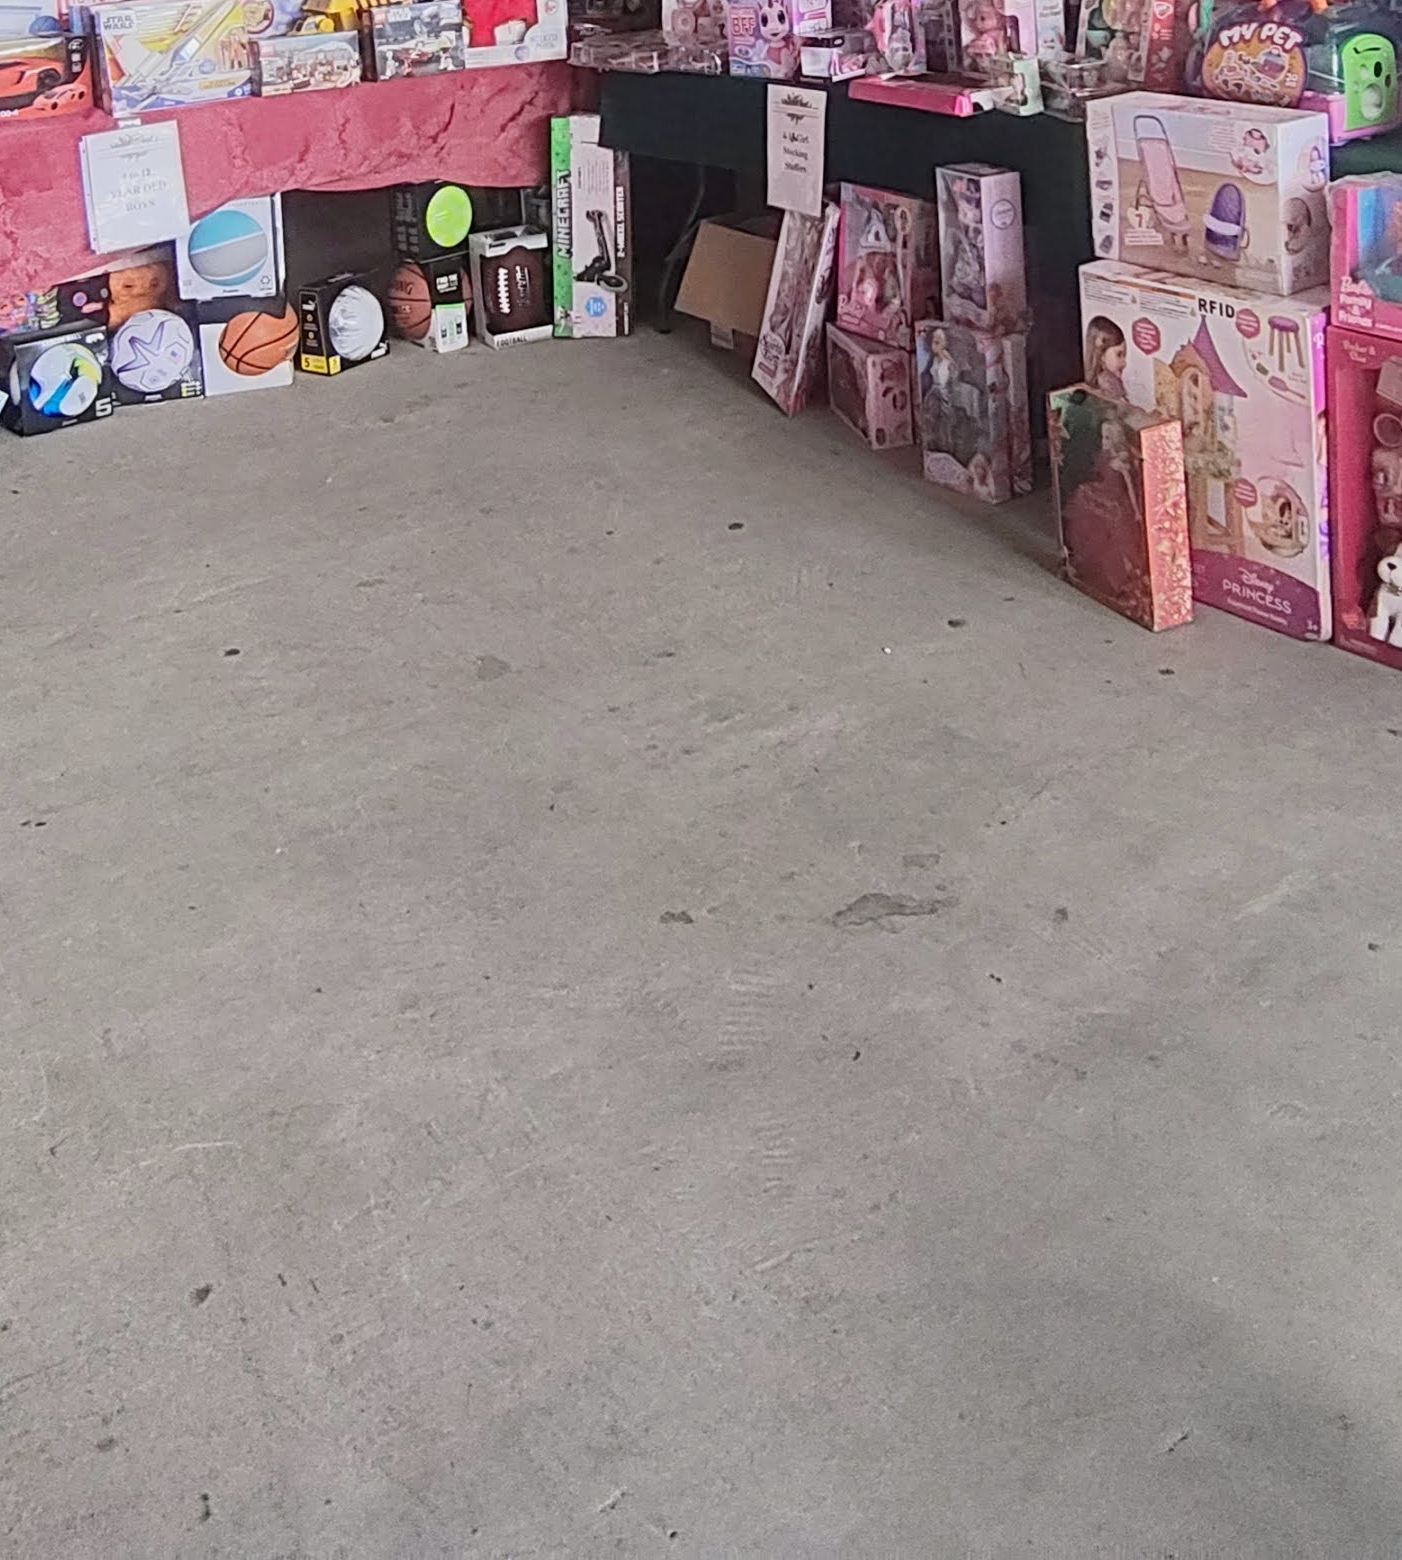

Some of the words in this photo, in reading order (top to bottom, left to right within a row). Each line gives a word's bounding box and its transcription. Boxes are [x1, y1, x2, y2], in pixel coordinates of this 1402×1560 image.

[103, 15, 133, 23] STAR
[103, 22, 135, 30] WARS
[732, 16, 756, 37] BFF
[1219, 23, 1258, 47] MY
[1260, 22, 1304, 50] PET
[556, 169, 573, 259] MINECRAFT
[1198, 297, 1236, 318] RFID
[303, 359, 311, 369] 5
[95, 397, 113, 417] 5
[1238, 566, 1275, 594] Disney
[1222, 578, 1293, 615] PRINCESS
